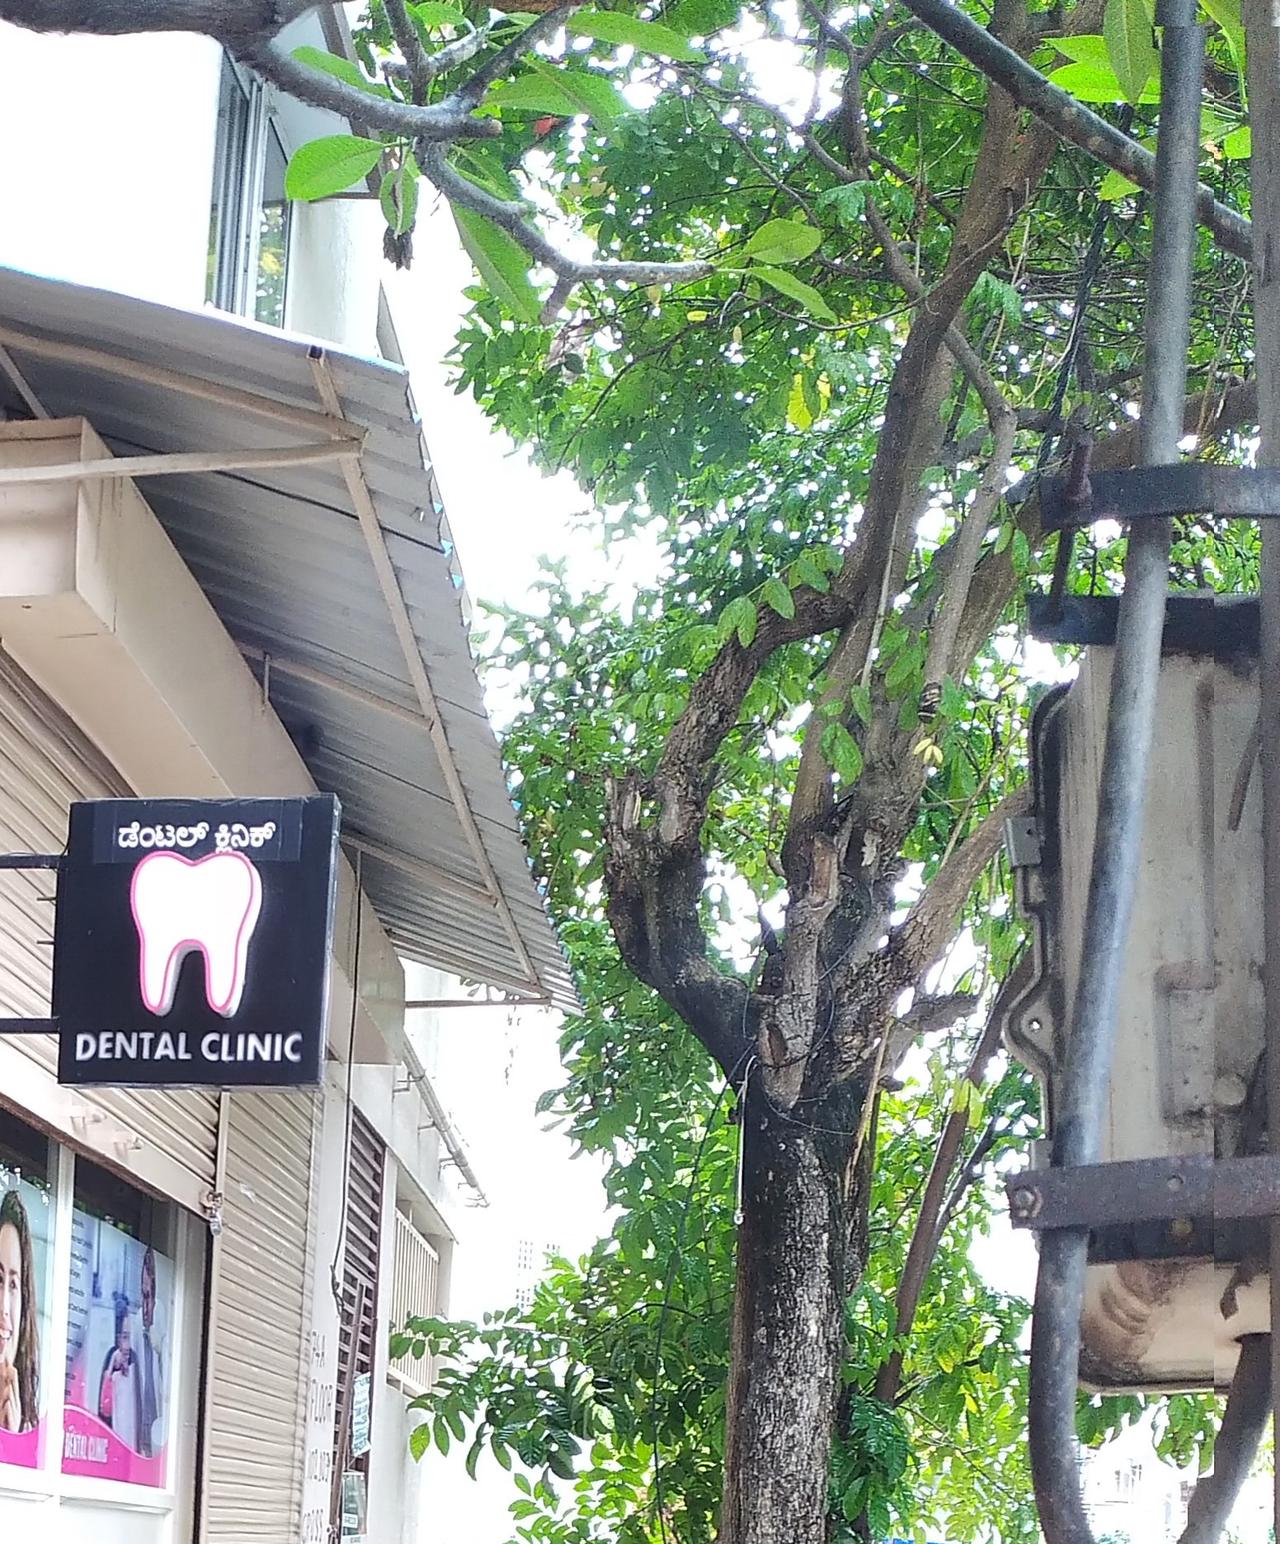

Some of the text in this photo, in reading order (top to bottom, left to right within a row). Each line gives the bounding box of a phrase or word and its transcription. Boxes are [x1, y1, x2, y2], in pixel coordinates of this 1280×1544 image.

[118, 821, 276, 853] ಡೆಂಟಲ್ ಕ್ಲಿನಿಕ್
[75, 1031, 303, 1063] DENTAL CLINIC
